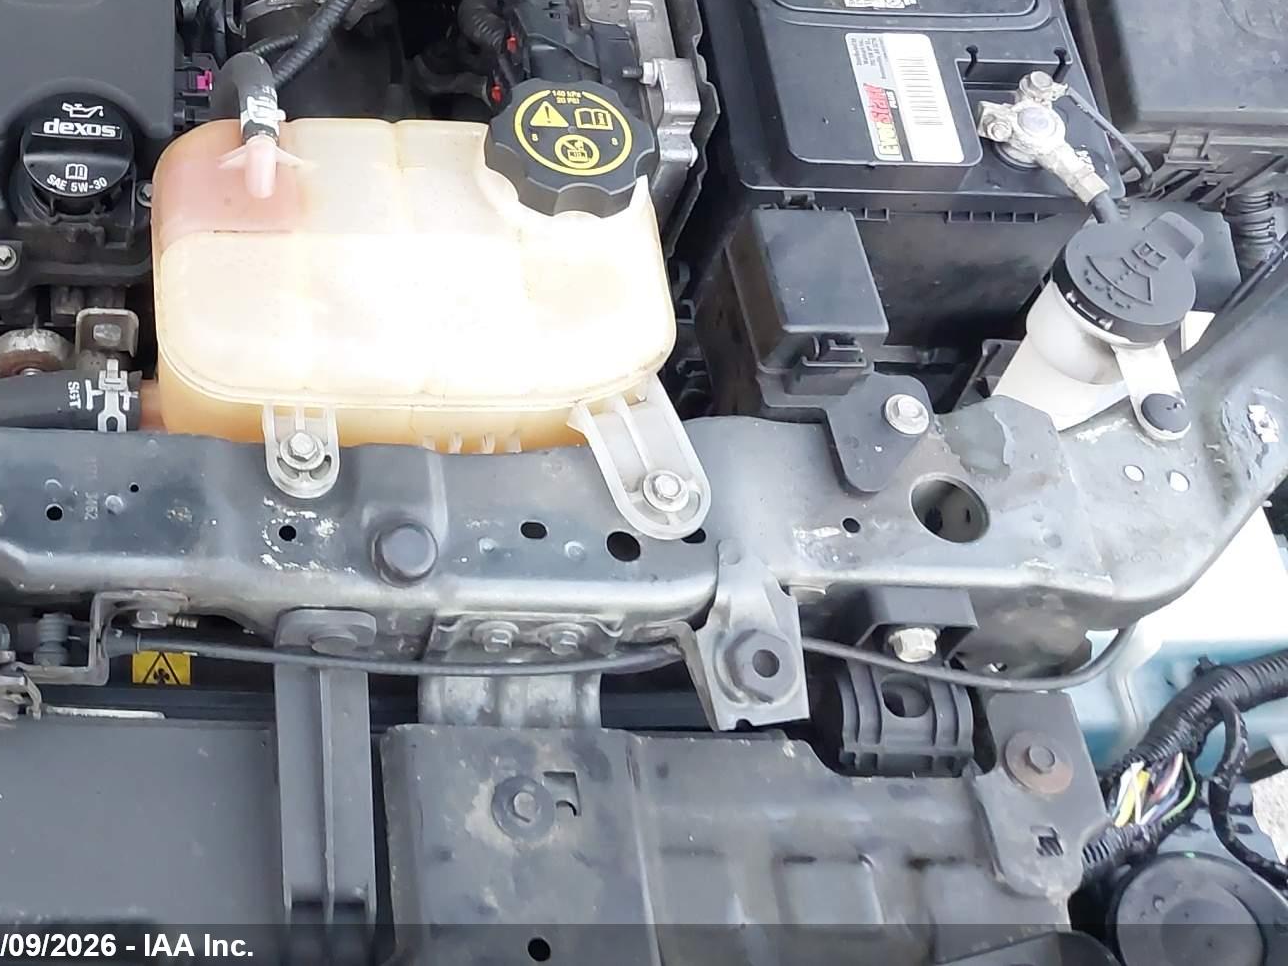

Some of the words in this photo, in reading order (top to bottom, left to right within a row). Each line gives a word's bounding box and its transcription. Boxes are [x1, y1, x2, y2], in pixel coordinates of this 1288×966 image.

[43, 118, 116, 138] dexos
[46, 174, 68, 191] SAE
[70, 177, 108, 193] 5W-30
